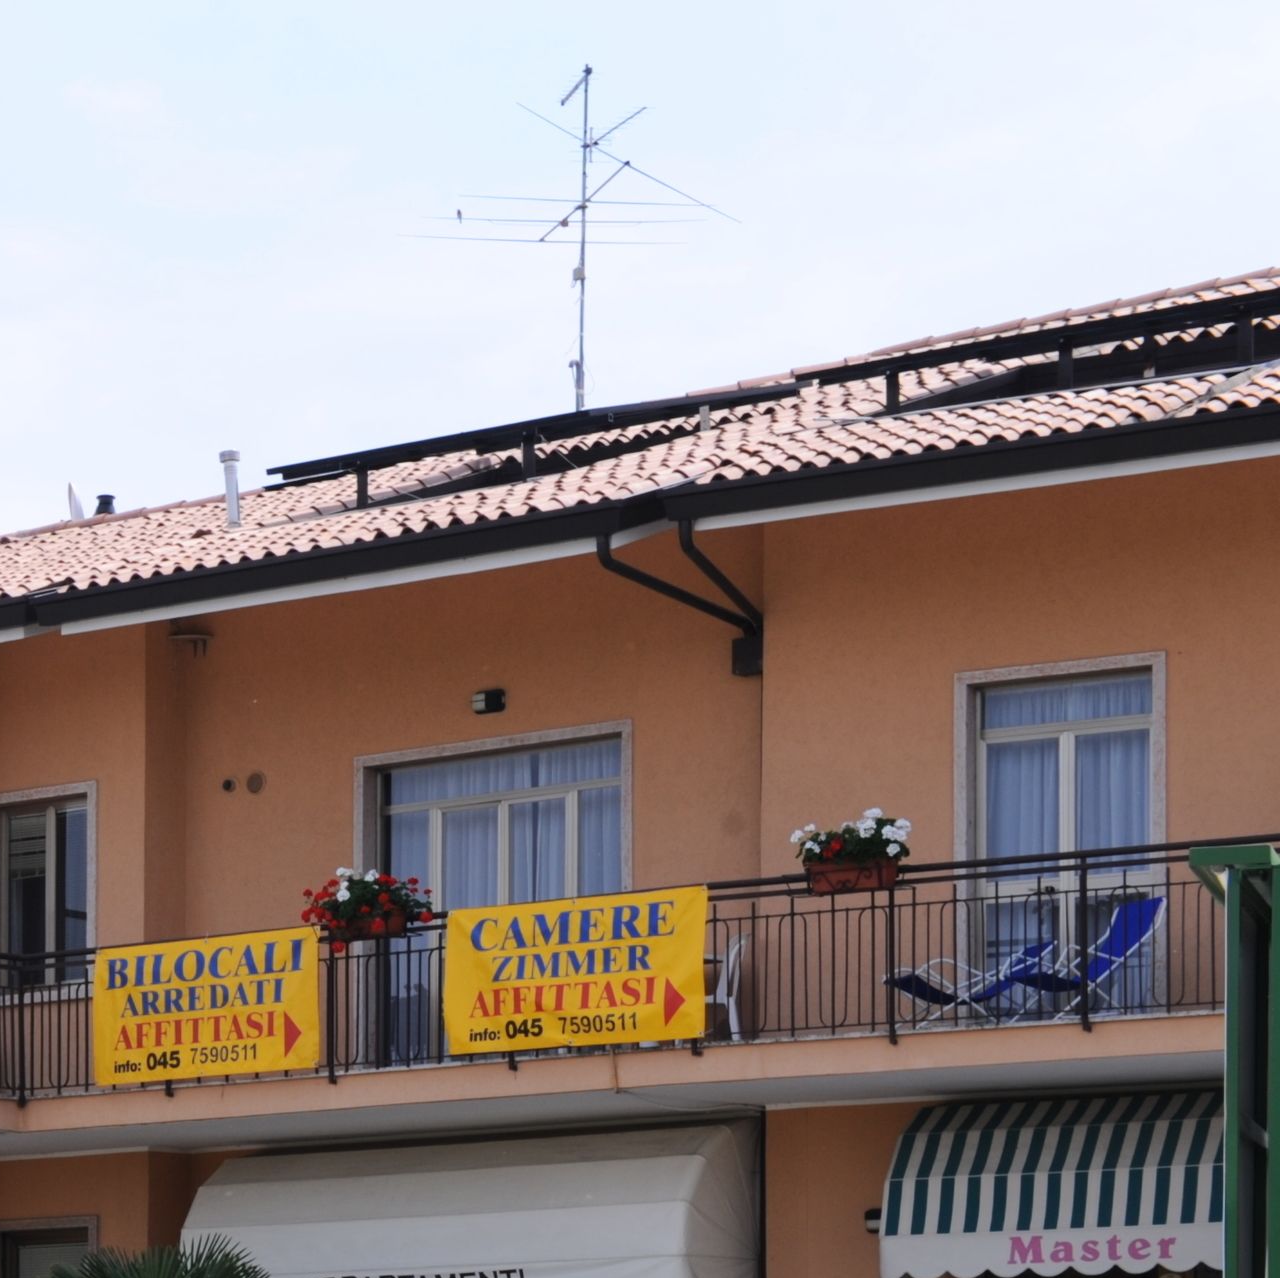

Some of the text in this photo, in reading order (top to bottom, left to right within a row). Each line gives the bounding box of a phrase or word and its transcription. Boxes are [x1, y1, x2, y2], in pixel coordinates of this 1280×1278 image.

[470, 900, 676, 952] CAMERE
[106, 938, 307, 990] BILOCALI
[492, 944, 652, 983] ZIMMER
[121, 978, 285, 1018] ARREDATI
[469, 976, 658, 1019] AFFITTASI
[114, 1011, 278, 1051] AFFITTASI
[469, 1012, 638, 1042] info: 045 7590511
[114, 1043, 258, 1074] info: 045 7590511
[1007, 1234, 1177, 1265] Master
